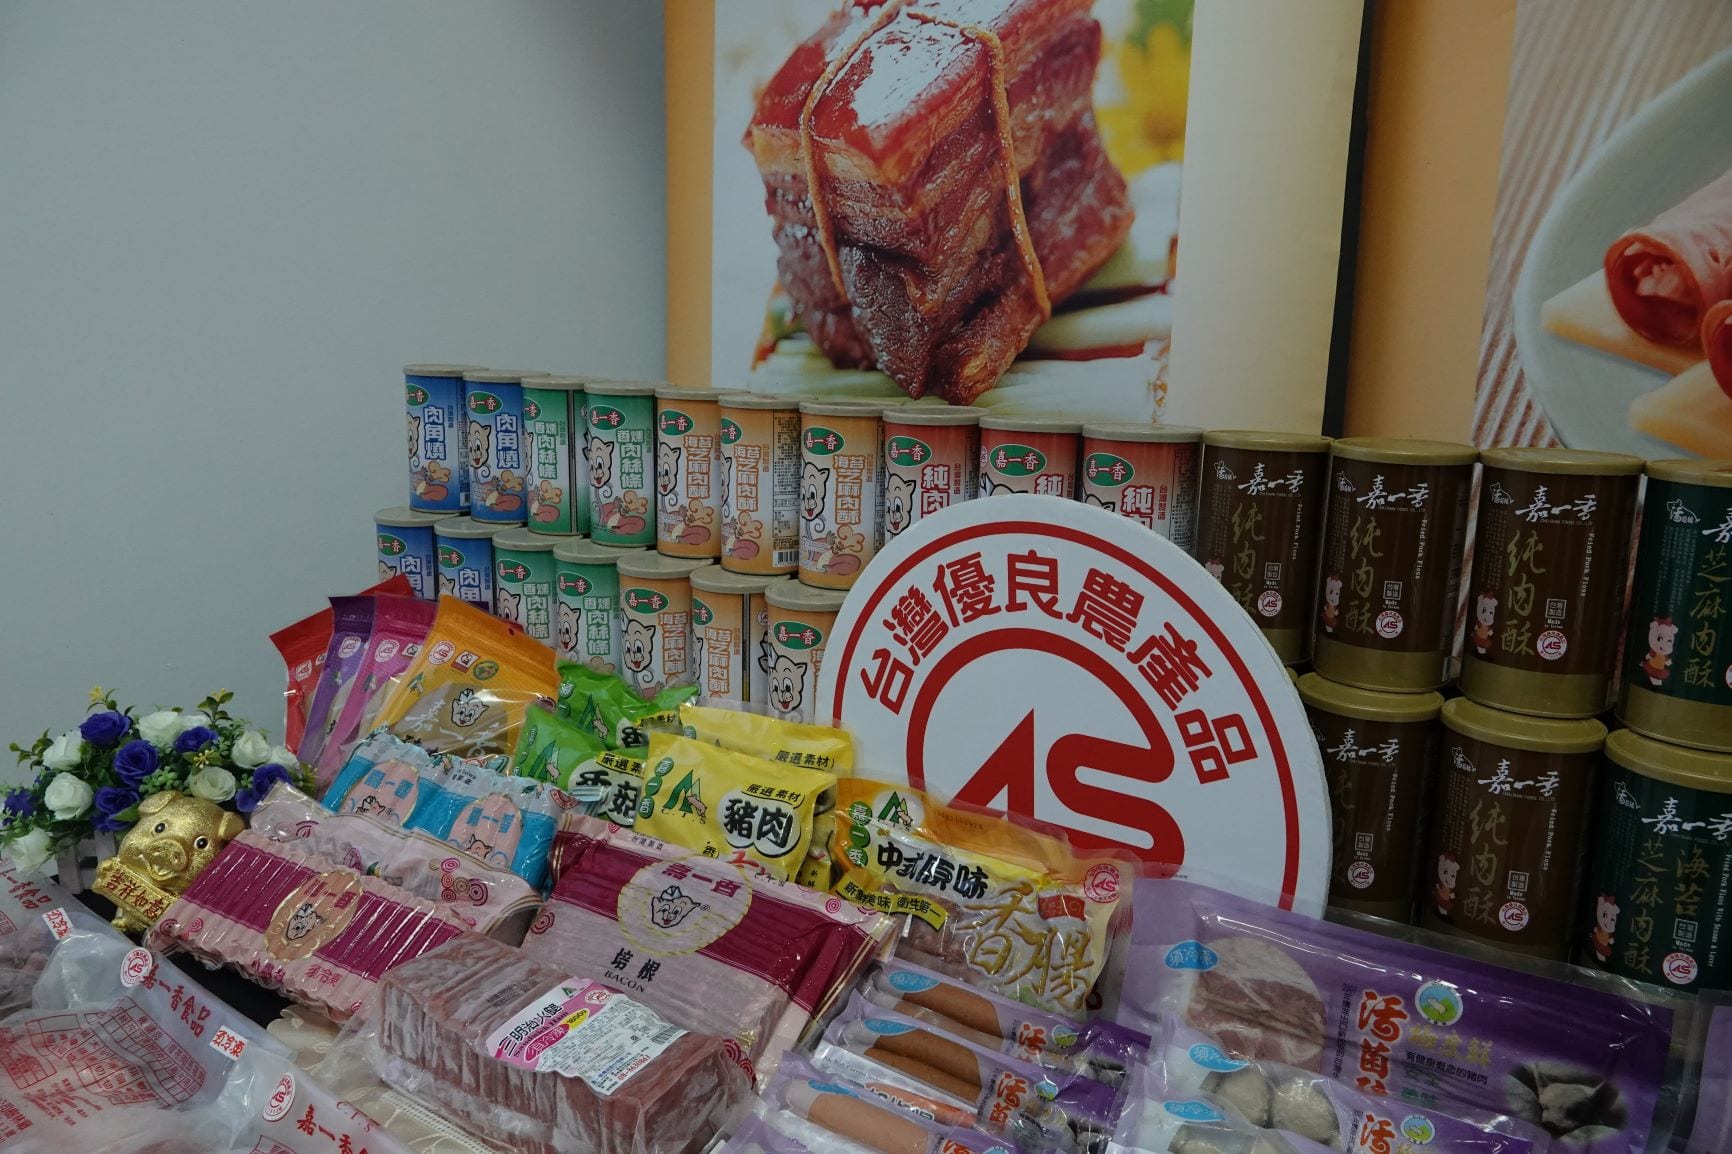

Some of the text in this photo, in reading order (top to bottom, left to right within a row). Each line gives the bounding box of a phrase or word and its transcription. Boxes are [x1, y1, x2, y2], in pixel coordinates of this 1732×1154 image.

[423, 405, 447, 461] 肉角燒
[496, 413, 520, 470] 肉角燒
[804, 430, 840, 451] 嘉一香
[889, 440, 925, 462] 嘉一香
[994, 449, 1041, 472] 嘉一香
[1087, 459, 1127, 481] 嘉一香
[1238, 462, 1306, 497] 嘉一香
[1357, 474, 1431, 510] 嘉一香
[1515, 484, 1598, 524] 嘉一香
[1344, 515, 1385, 635] 純肉酥
[1500, 529, 1547, 657] 純肉酥
[627, 591, 663, 611] 嘉一香
[1683, 546, 1732, 689] 芝麻肉酥
[776, 626, 817, 647] 嘉一香
[859, 549, 1259, 785] 台灣優良農產品
[774, 749, 831, 768] 嚴選素材
[1327, 728, 1401, 763] 嘉一香
[745, 783, 801, 802] 嚴選素材
[1477, 758, 1561, 798] 嘉一香
[723, 797, 794, 849] 豬肉
[1641, 796, 1732, 841] 嘉一香
[876, 840, 989, 899] 中式原味
[1462, 799, 1510, 926] 純肉酥
[1673, 845, 1711, 916] 海苔
[102, 871, 166, 921] 吉祥如意
[1623, 837, 1670, 975] 芝麻肉酥
[604, 970, 647, 993] BACON
[610, 947, 662, 984] 培根
[141, 963, 212, 1038] 嘉一香食品
[499, 1002, 564, 1057] 三明治火腿
[296, 1103, 368, 1154] 嘉一香
